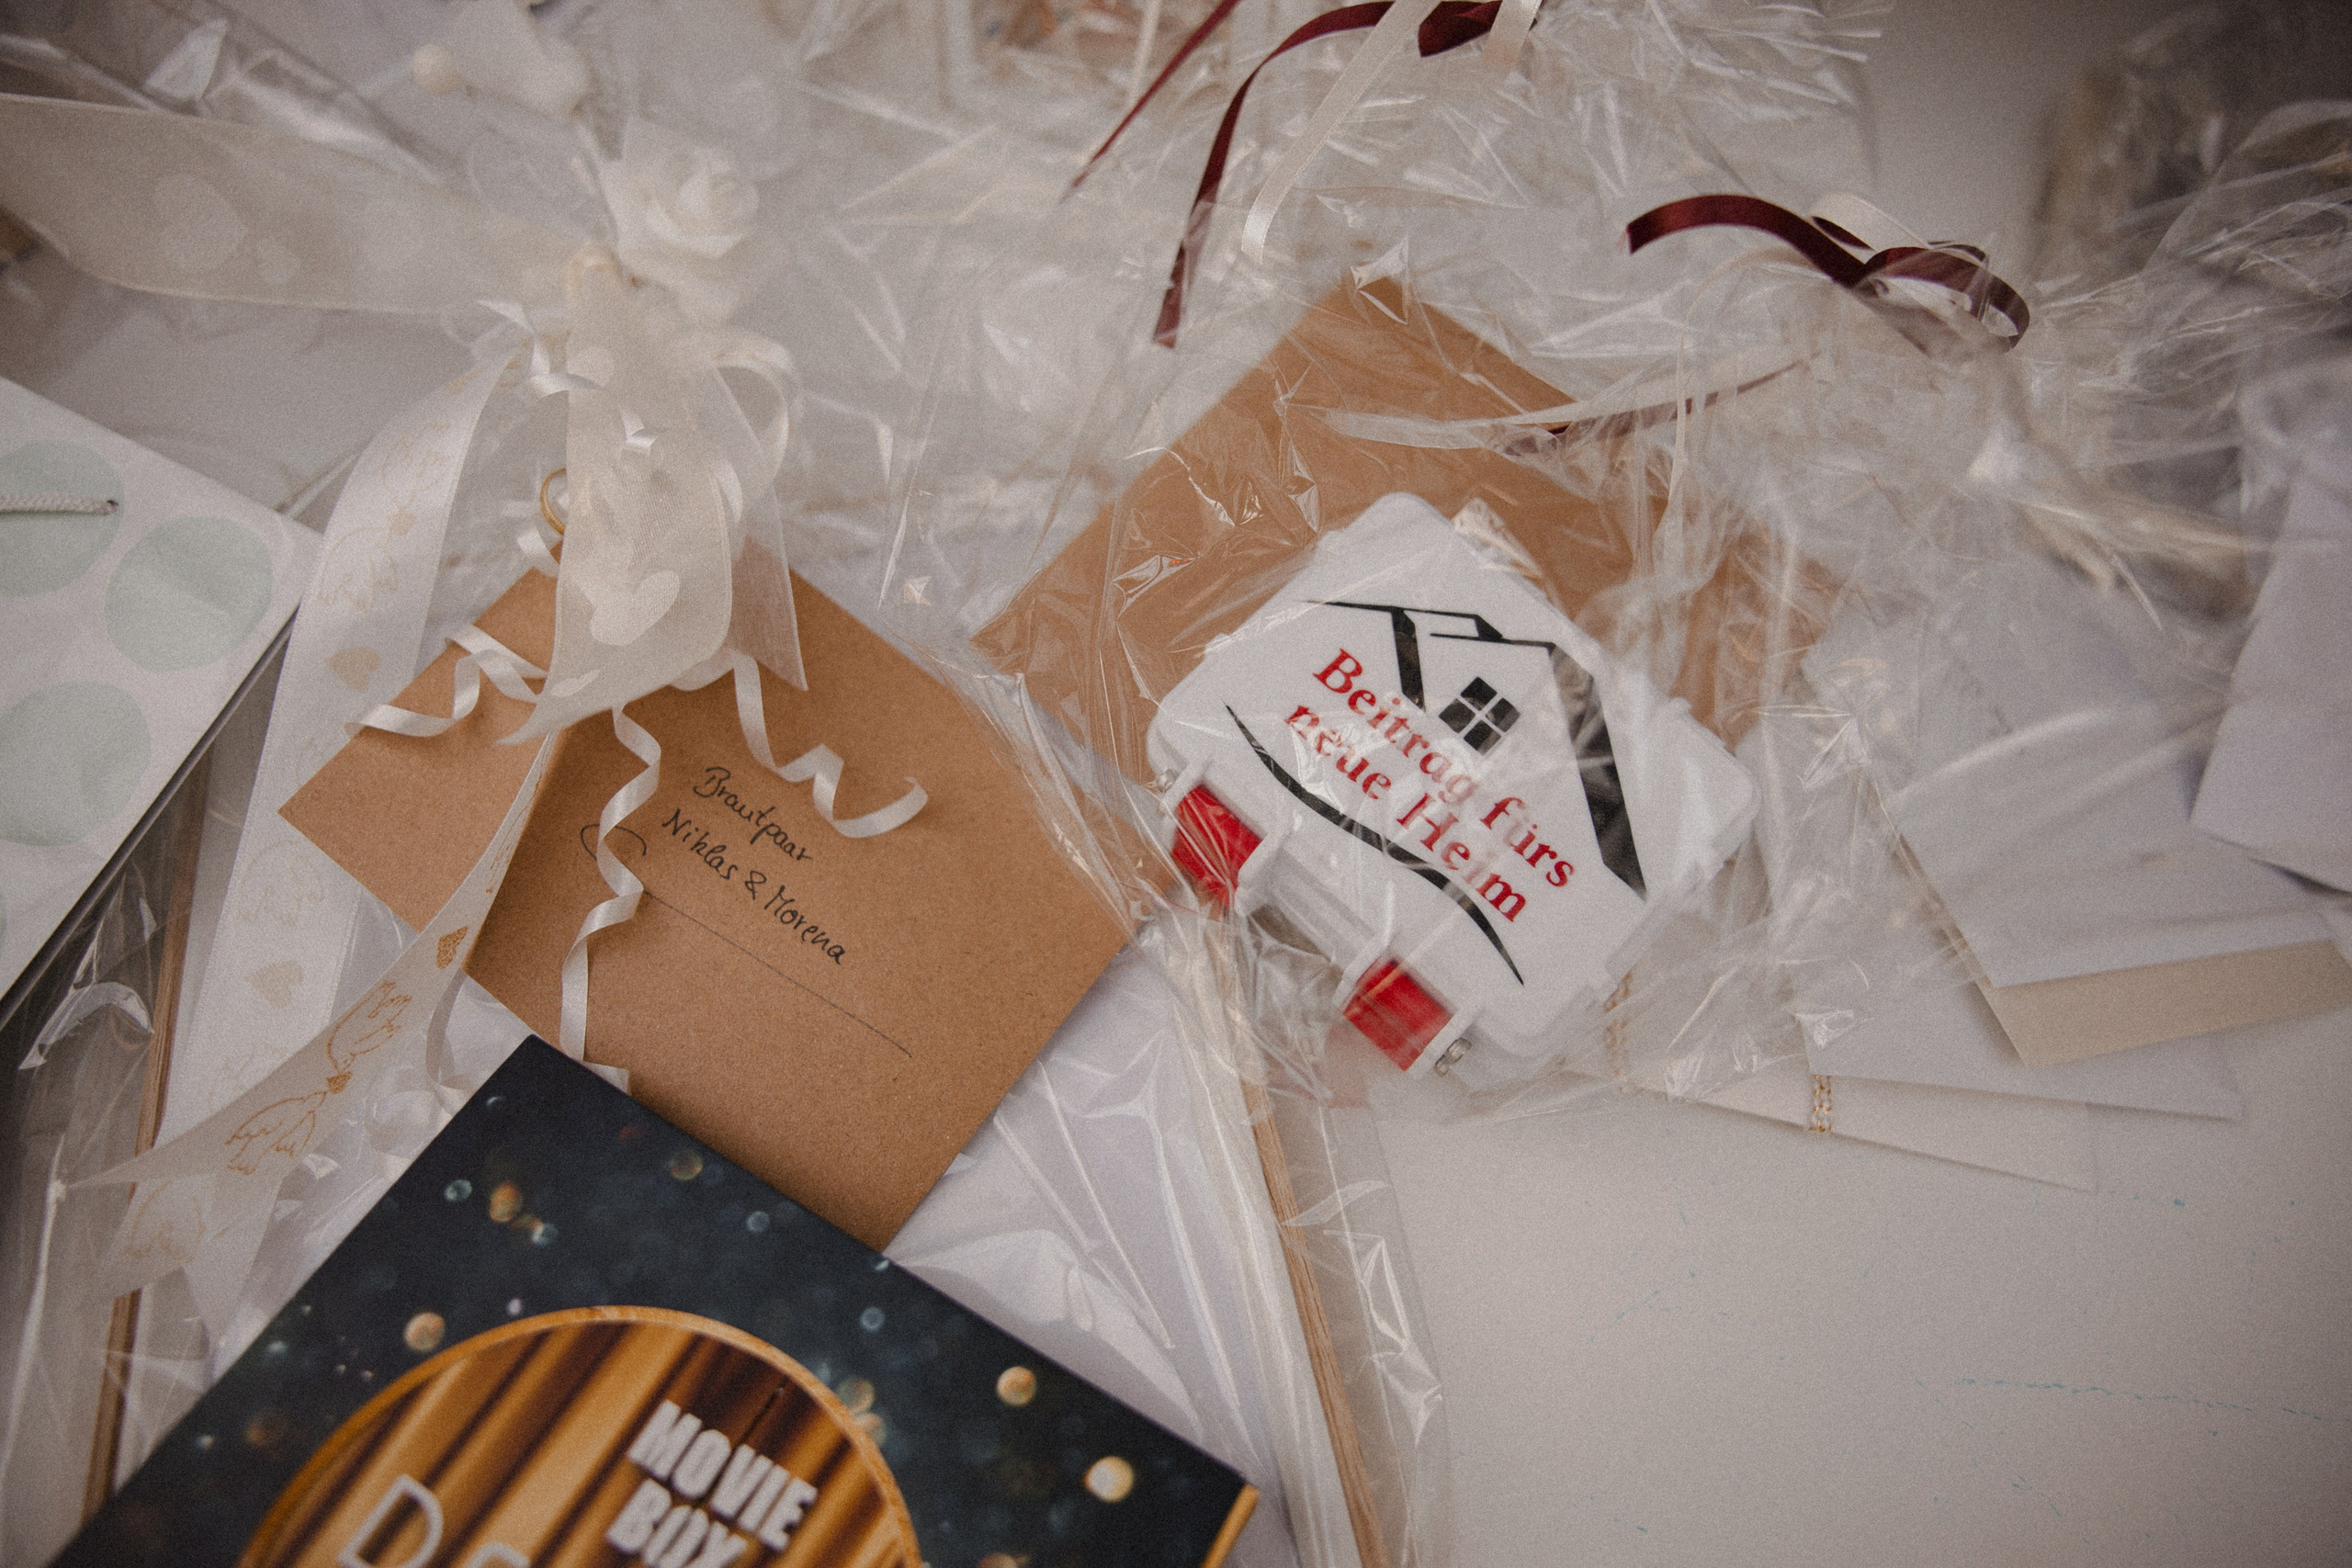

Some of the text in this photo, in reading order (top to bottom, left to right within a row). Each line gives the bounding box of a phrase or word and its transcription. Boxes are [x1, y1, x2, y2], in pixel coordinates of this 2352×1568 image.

[693, 766, 813, 862] Brautpaar
[1283, 705, 1527, 923] neue Heim
[1313, 648, 1575, 888] Beitrag fürs
[743, 870, 768, 901] &
[764, 885, 847, 966] Morena
[604, 1477, 750, 1568] BOX
[626, 1399, 819, 1552] MOVIE
